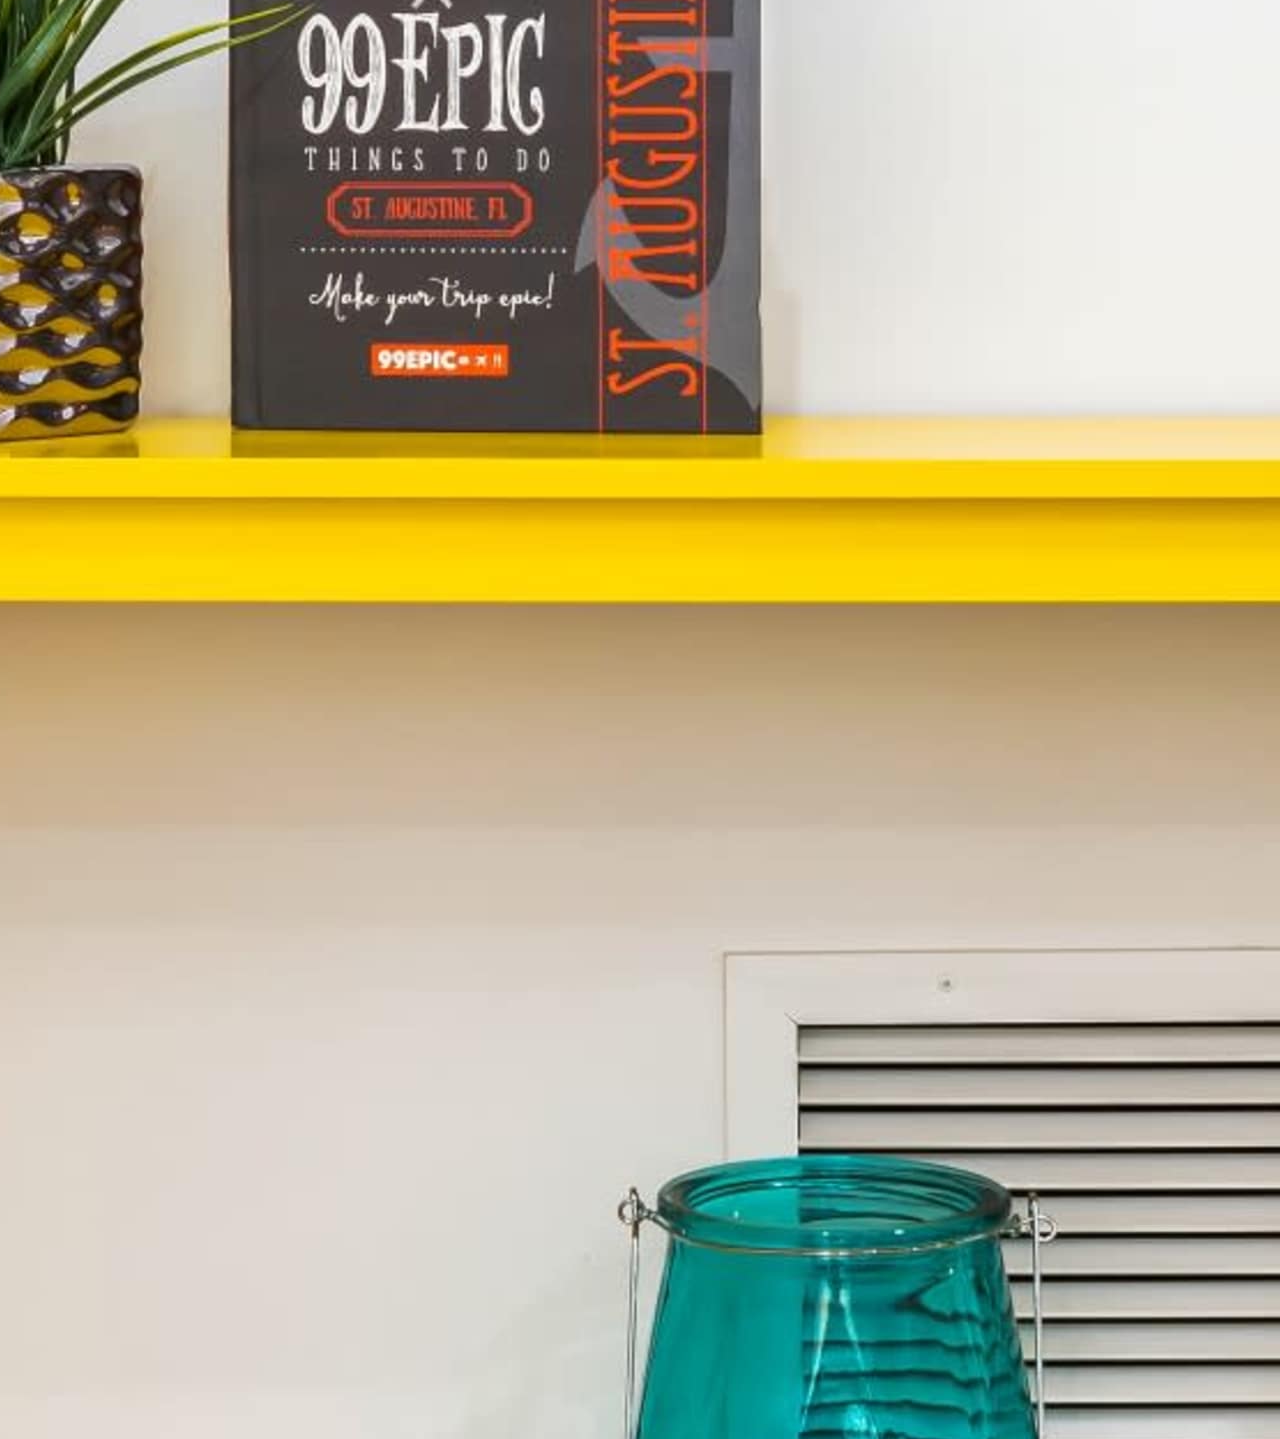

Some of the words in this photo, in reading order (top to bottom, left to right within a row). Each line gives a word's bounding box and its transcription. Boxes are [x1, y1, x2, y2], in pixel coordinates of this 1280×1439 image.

[304, 146, 424, 172] THINGS
[451, 146, 489, 172] TO
[516, 146, 551, 172] DO
[308, 272, 380, 323] Make
[385, 290, 434, 326] your
[429, 276, 492, 319] trip
[499, 271, 555, 319] epic!
[607, 313, 699, 398] ST.
